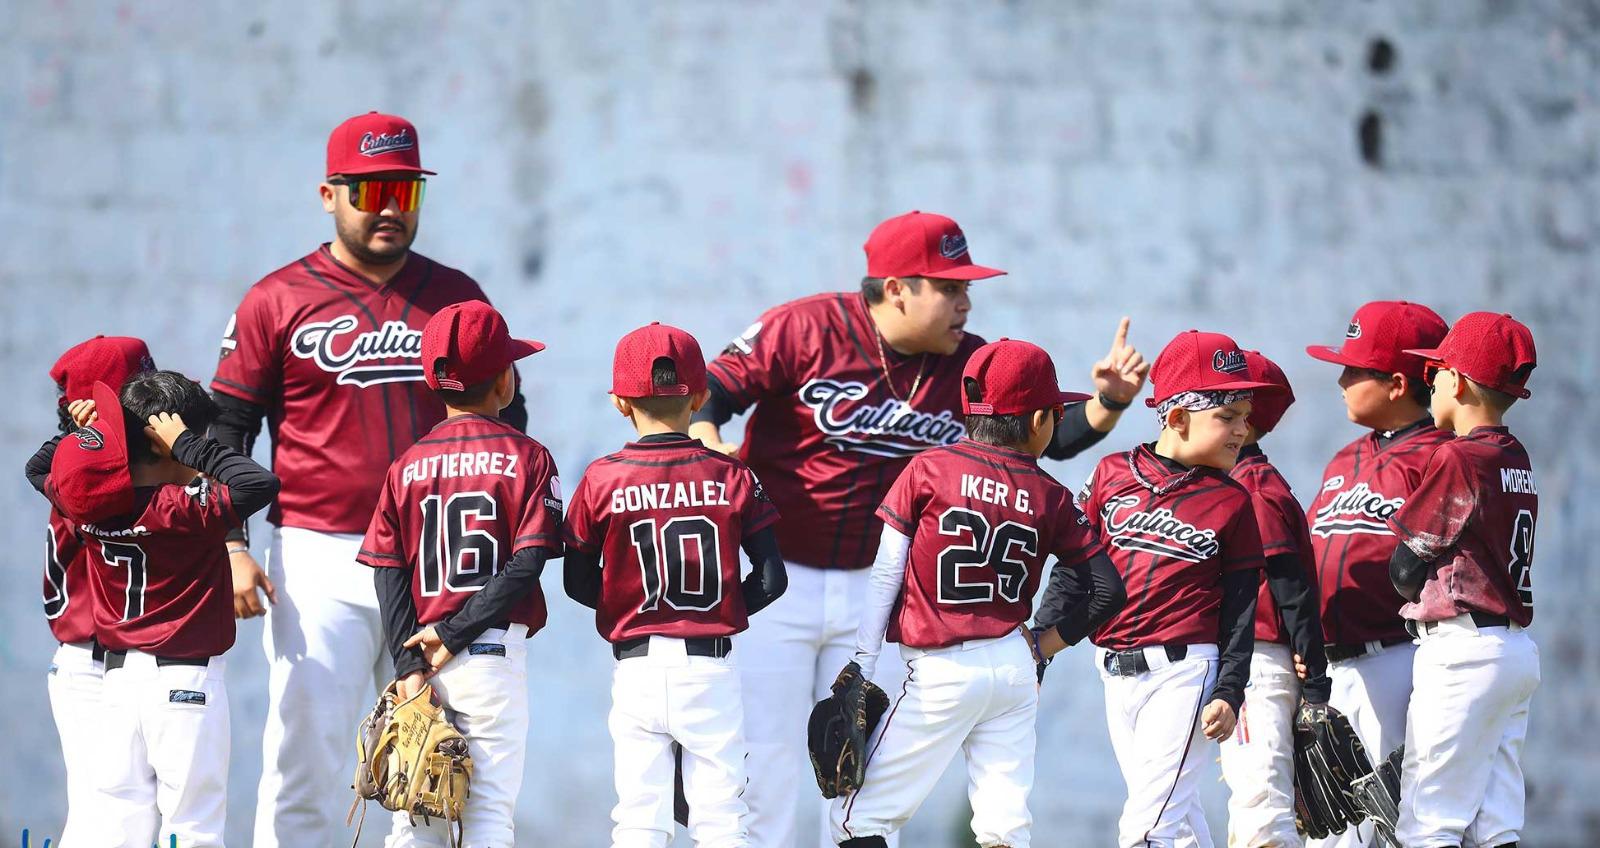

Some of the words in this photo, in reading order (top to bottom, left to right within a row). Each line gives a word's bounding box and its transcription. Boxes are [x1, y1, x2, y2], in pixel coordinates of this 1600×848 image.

[291, 315, 422, 372] Culia
[800, 379, 966, 446] Culiacán
[403, 451, 519, 487] GUTIERREZ
[611, 481, 730, 514] GONZALEZ
[961, 474, 1008, 507] IKER
[1013, 488, 1034, 516] G.
[419, 490, 498, 598] 16
[936, 506, 1039, 604] 26
[1101, 496, 1219, 560] Culiacán
[98, 539, 147, 624] 7
[629, 515, 722, 614] 10
